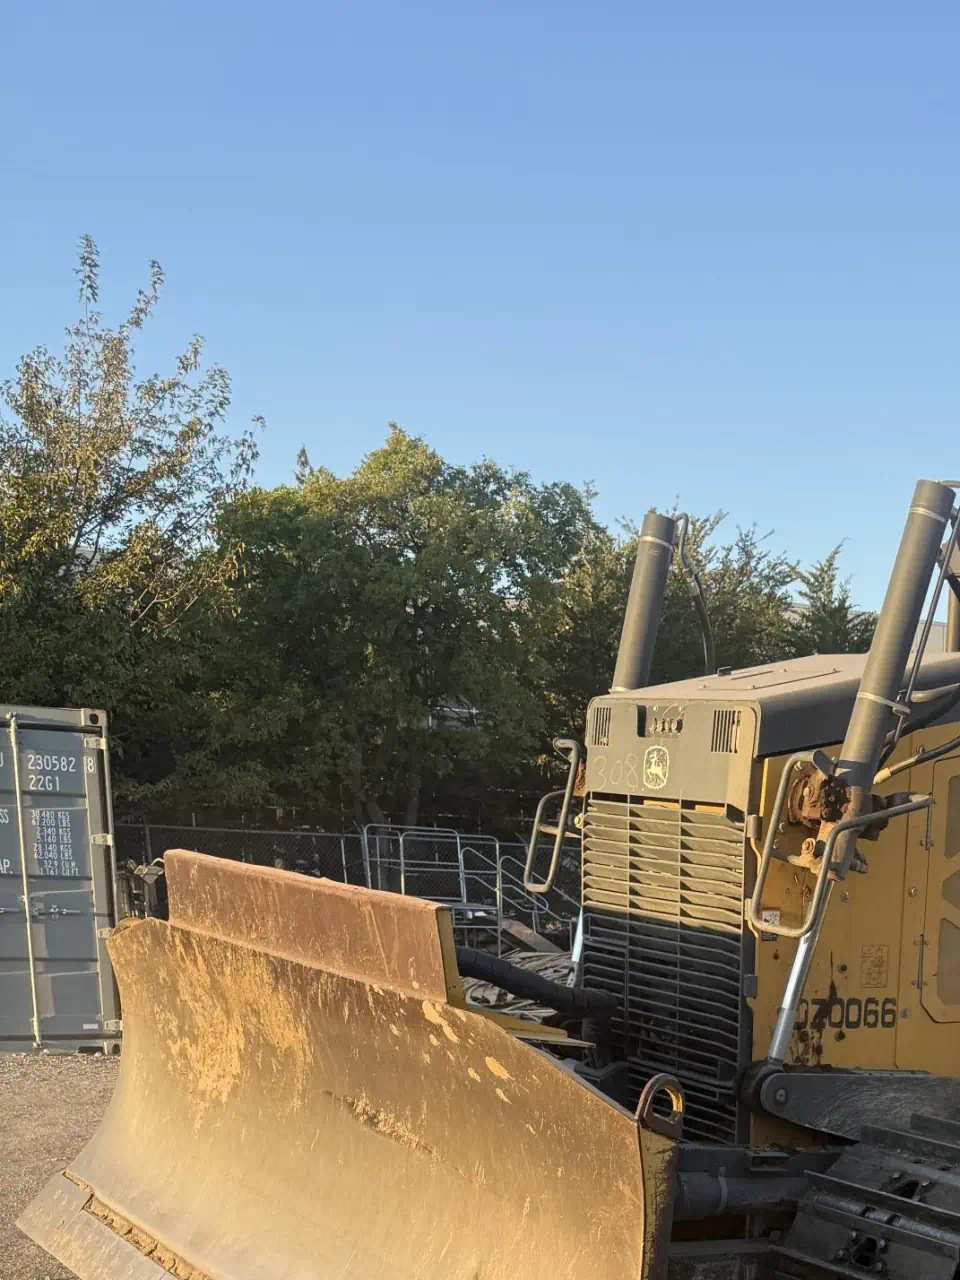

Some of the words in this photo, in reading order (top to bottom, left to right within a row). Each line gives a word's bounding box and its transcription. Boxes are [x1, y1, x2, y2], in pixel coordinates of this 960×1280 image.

[28, 754, 76, 772] 230582
[87, 757, 95, 772] 8
[592, 753, 638, 791] 308
[29, 775, 60, 791] 22G1
